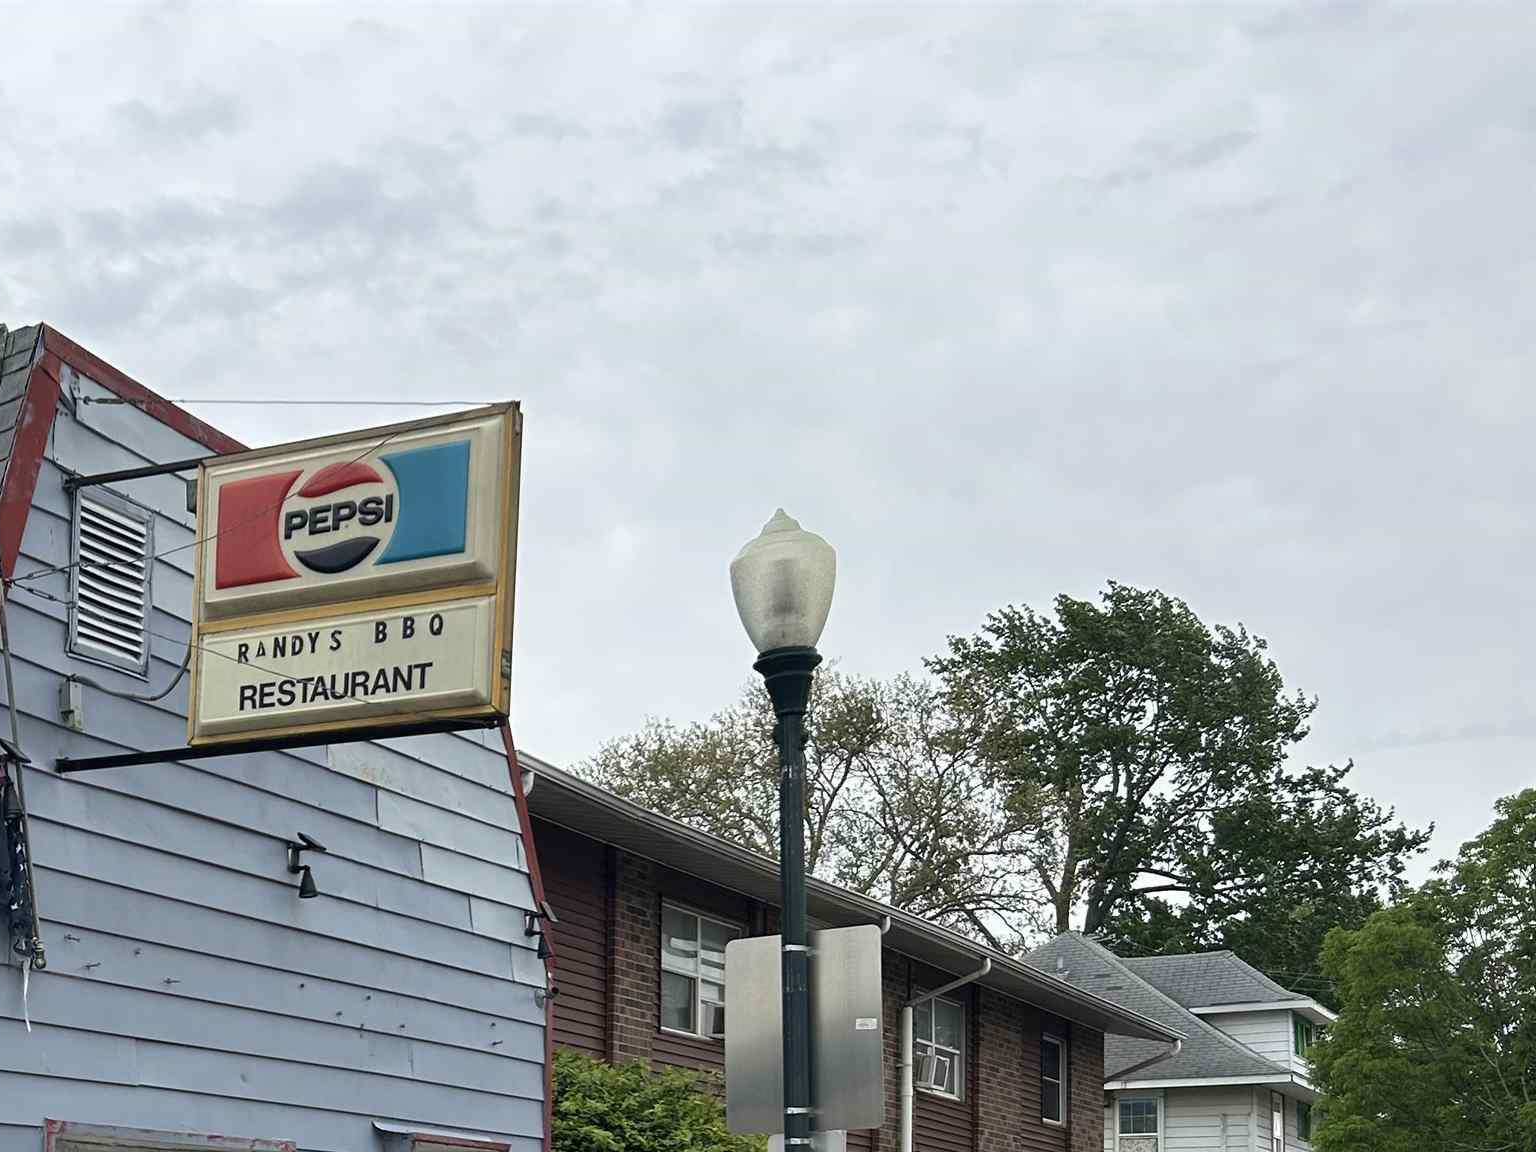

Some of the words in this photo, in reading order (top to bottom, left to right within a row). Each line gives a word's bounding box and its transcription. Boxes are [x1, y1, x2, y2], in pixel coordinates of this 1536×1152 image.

[284, 494, 394, 540] PEPSI
[238, 630, 342, 664] RANDYS
[374, 614, 444, 644] BBQ
[239, 662, 433, 711] RESTAURANT
